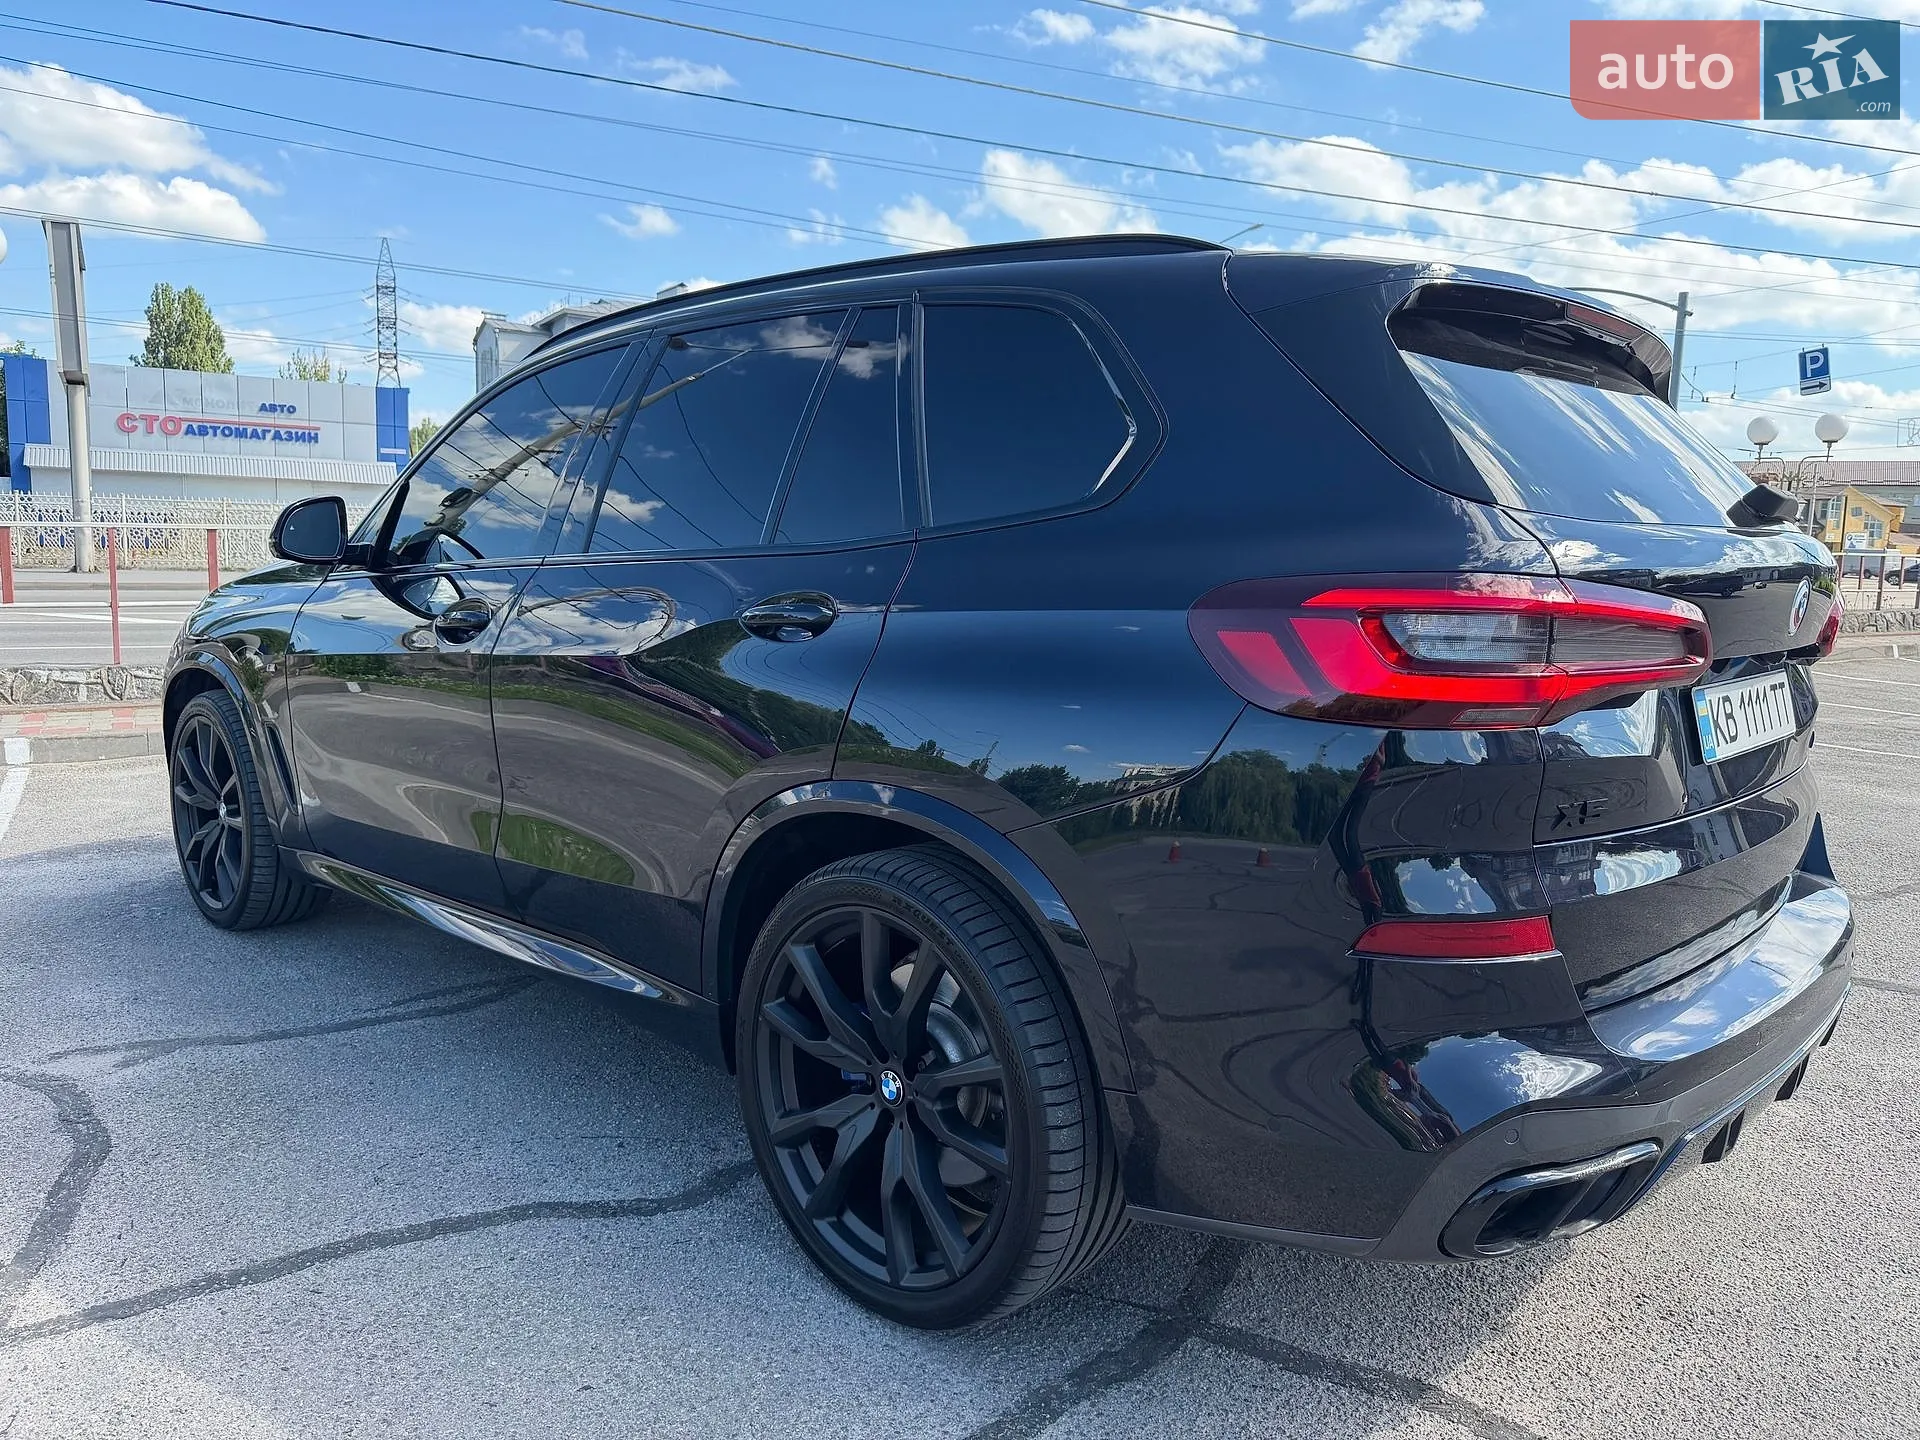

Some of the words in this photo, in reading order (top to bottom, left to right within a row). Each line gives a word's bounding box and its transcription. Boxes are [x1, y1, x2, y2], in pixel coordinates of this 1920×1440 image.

[1806, 351, 1824, 377] P
[258, 402, 297, 415] АВТО
[116, 412, 183, 436] СТО
[184, 424, 319, 444] АВТОМАГАЗИН
[1708, 695, 1738, 748] KB
[1739, 685, 1774, 738] 1111
[1769, 681, 1790, 728] TT
